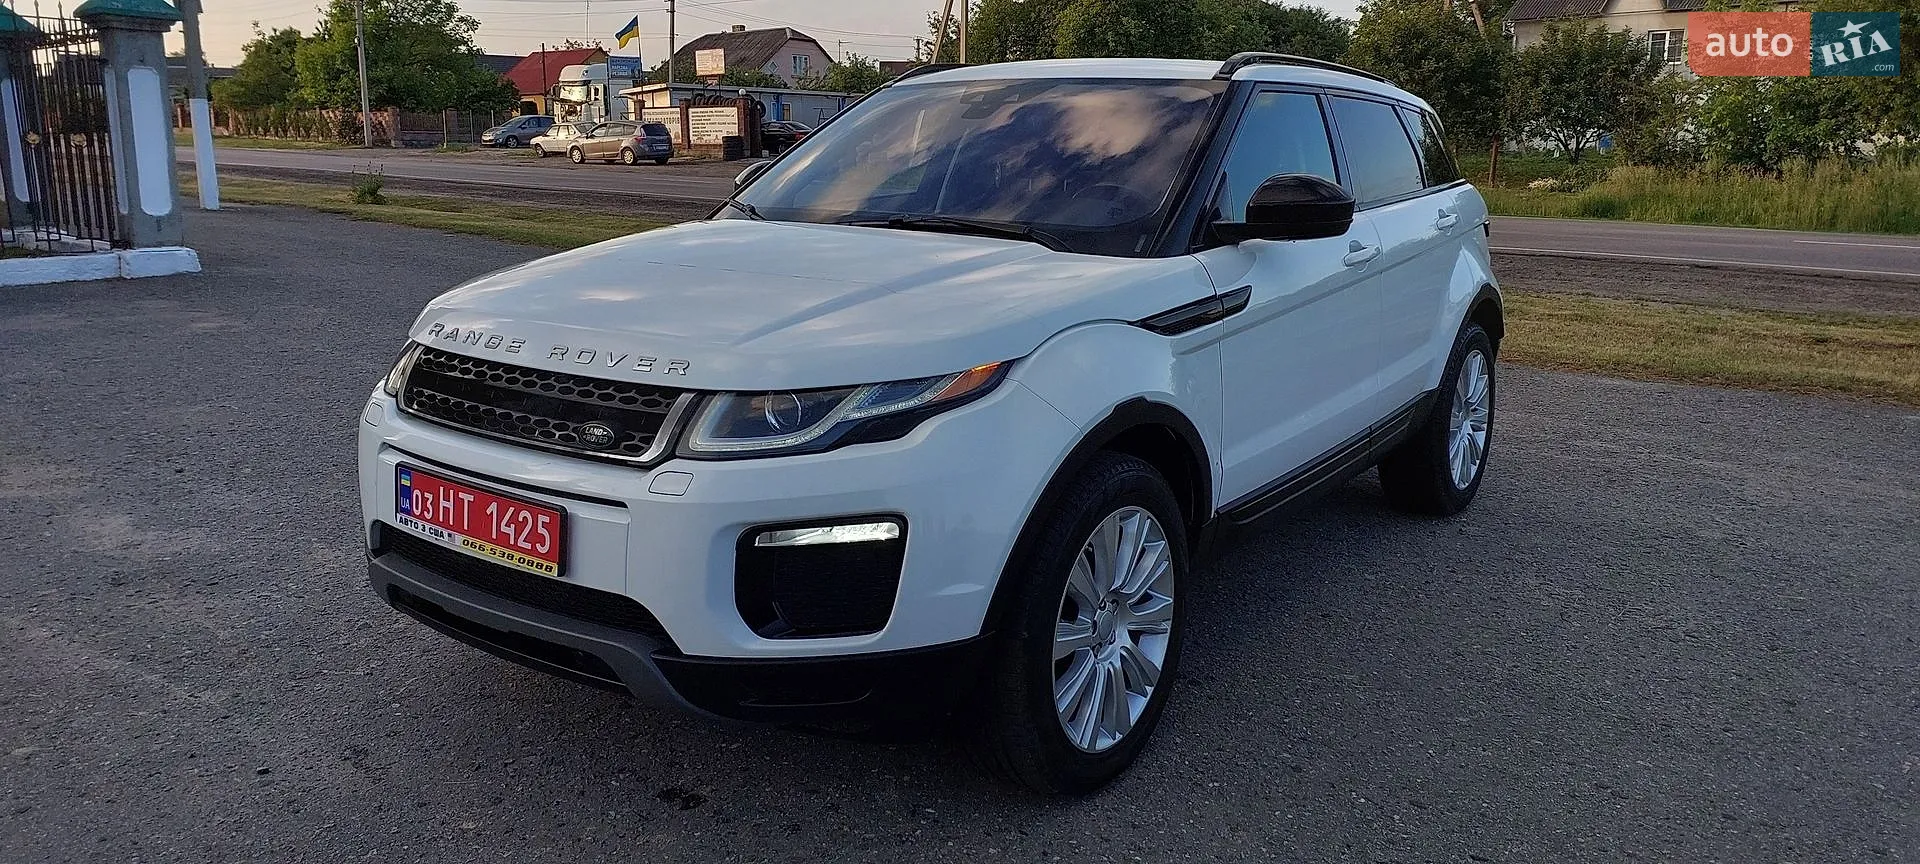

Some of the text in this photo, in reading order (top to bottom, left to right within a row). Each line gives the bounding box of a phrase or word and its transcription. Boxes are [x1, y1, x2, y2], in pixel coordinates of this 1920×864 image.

[428, 322, 690, 376] RANGE ROVER
[400, 498, 411, 510] UA
[412, 486, 550, 554] 03 HT 1425
[398, 516, 419, 530] АВТО
[428, 526, 445, 540] США
